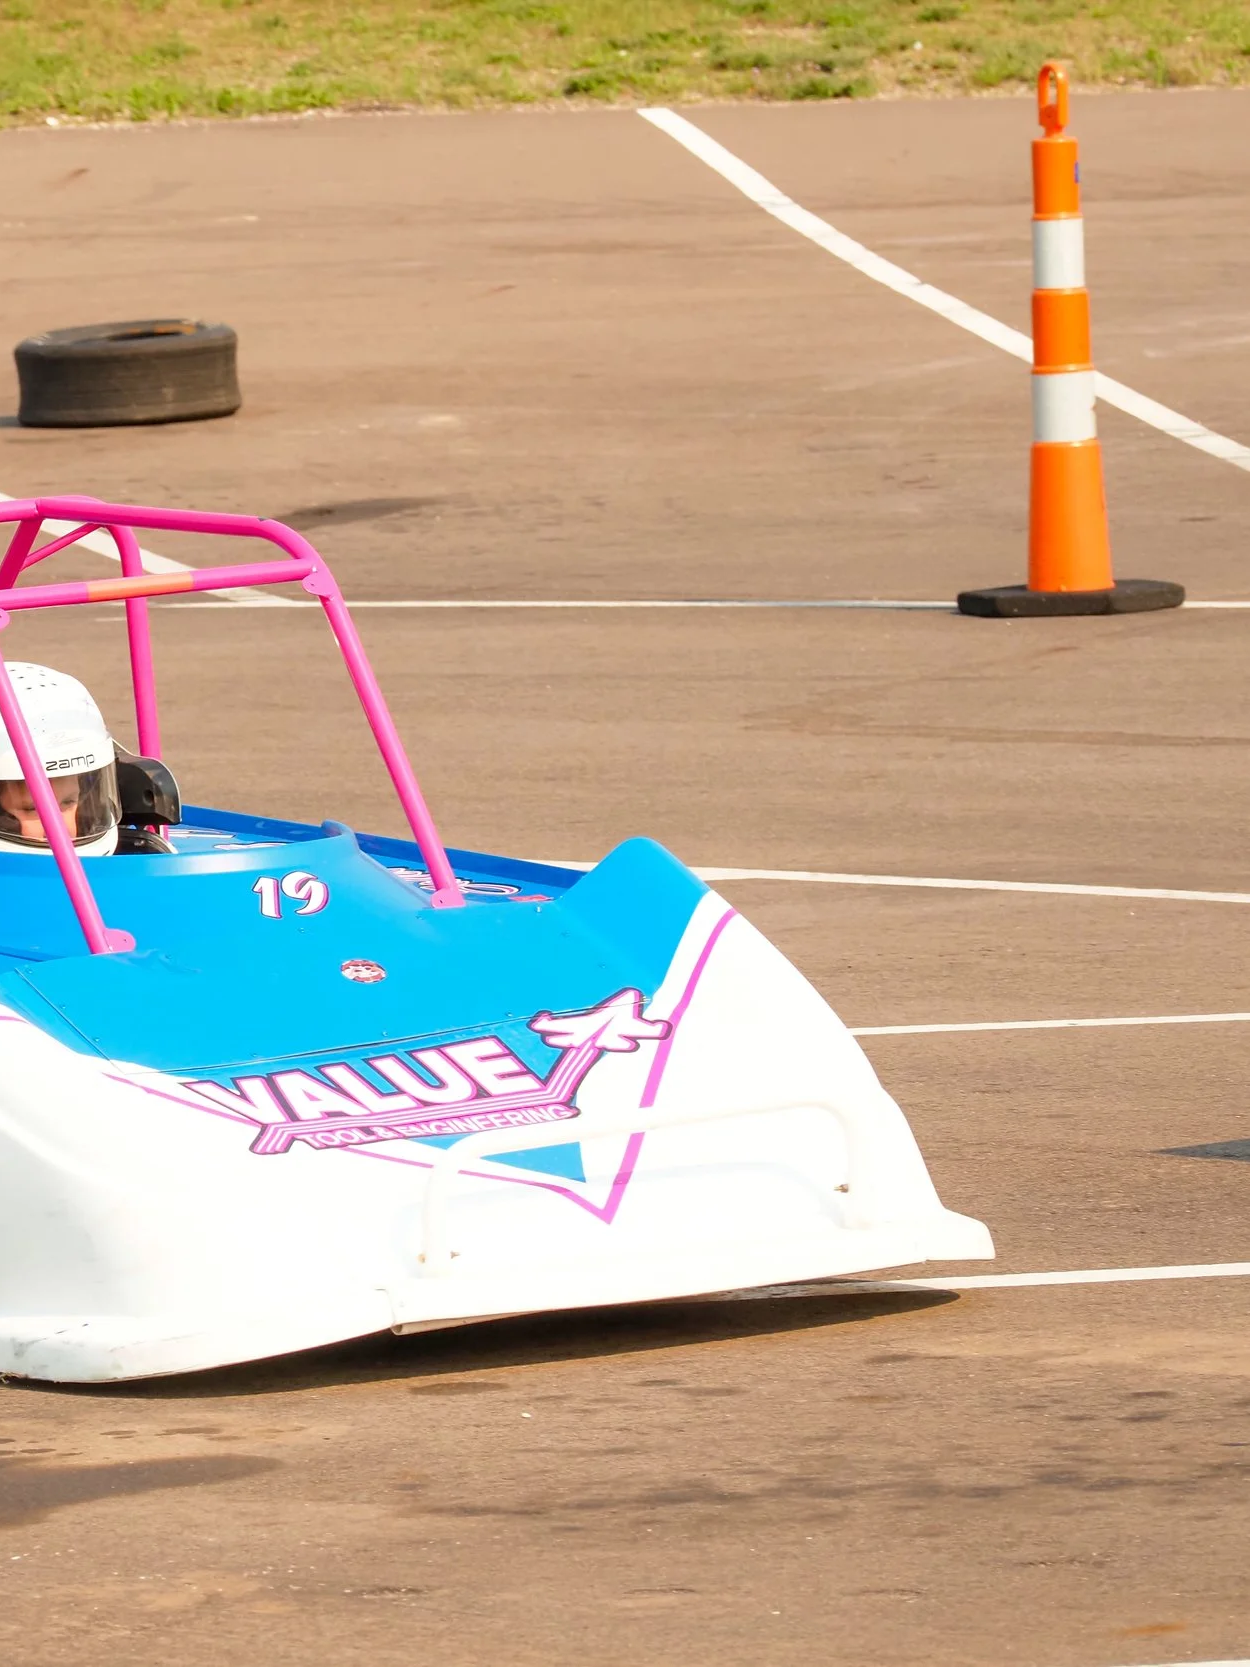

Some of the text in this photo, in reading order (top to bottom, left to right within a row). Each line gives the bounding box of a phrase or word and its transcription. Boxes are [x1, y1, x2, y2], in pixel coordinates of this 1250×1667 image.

[45, 754, 95, 771] zamp
[252, 871, 329, 919] 19
[180, 1035, 546, 1126] VALUE
[300, 1104, 573, 1148] TOOL & ENGINEERING
